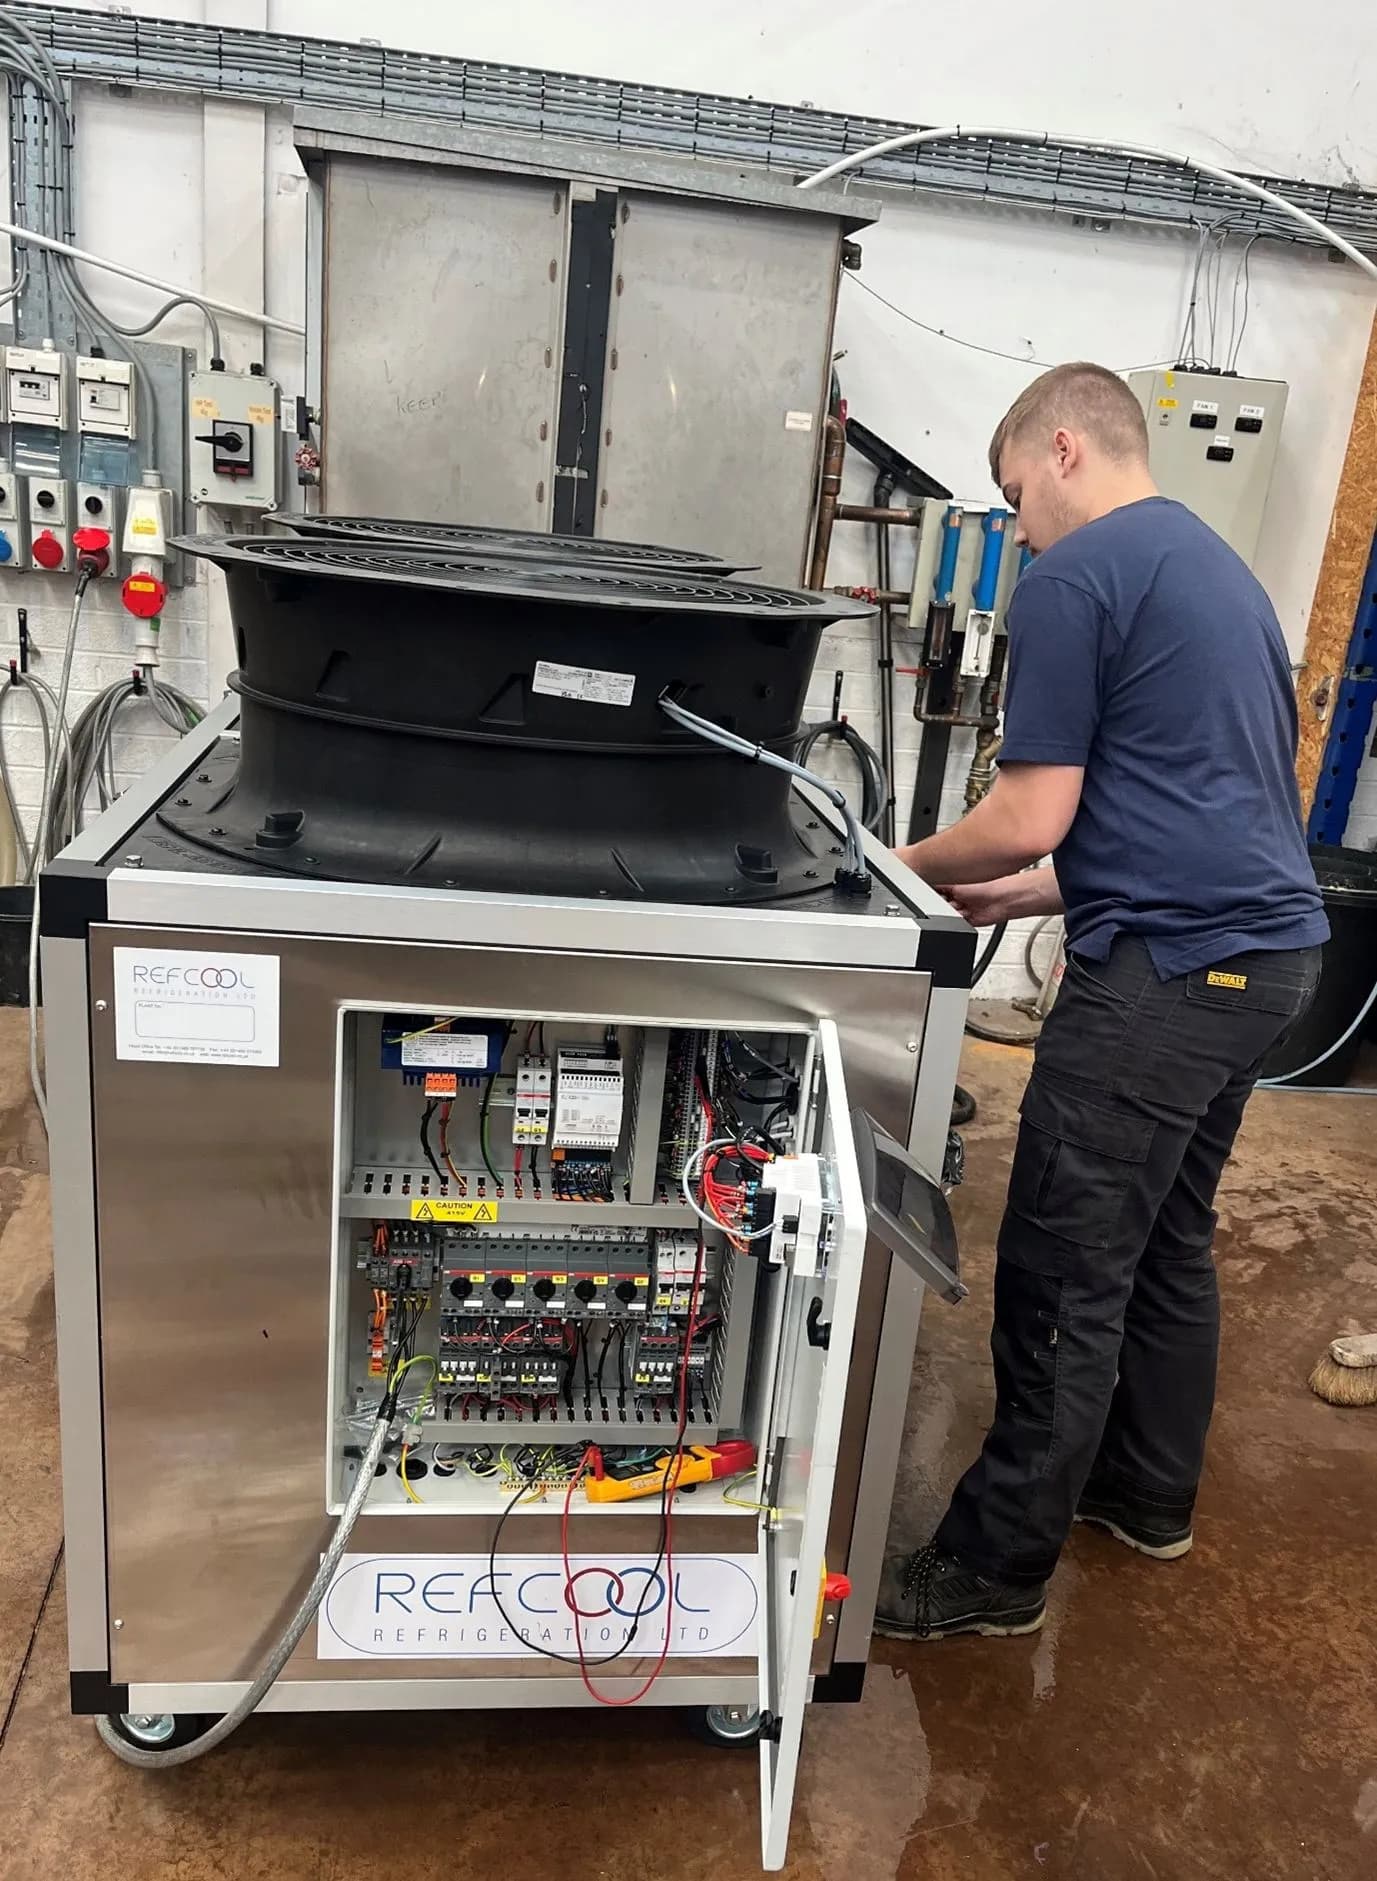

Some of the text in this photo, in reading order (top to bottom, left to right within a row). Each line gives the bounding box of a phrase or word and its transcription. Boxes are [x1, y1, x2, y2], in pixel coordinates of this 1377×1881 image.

[133, 965, 255, 989] REFCOOL
[133, 987, 228, 999] REFRIGERATION
[376, 1567, 710, 1618] REFCOOL
[373, 1627, 709, 1642] REFRIGERATION LTD
